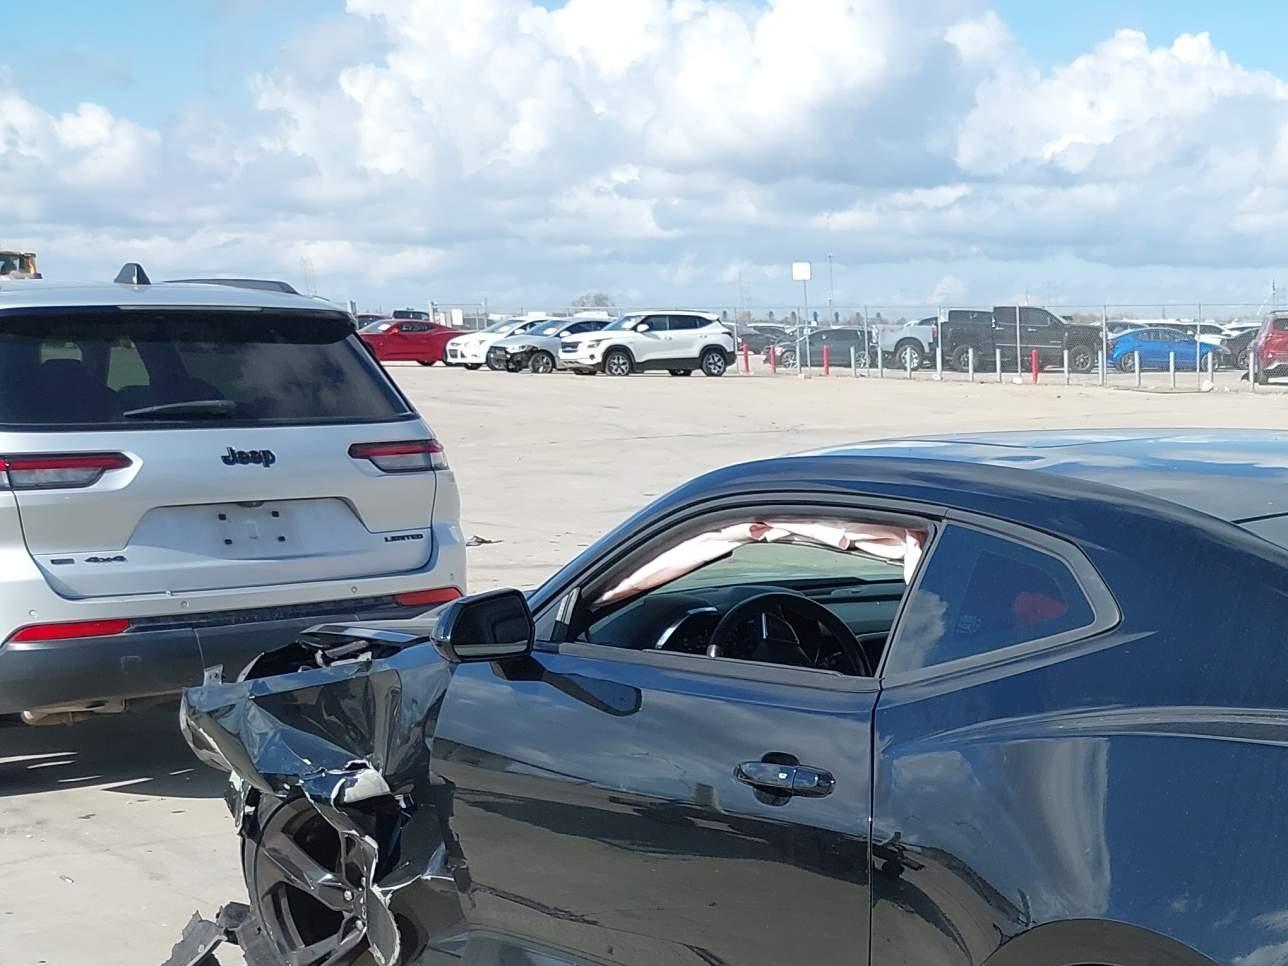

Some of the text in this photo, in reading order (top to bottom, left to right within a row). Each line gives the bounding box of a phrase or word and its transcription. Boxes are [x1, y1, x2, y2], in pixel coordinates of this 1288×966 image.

[221, 447, 275, 467] Jeep
[384, 533, 423, 542] LIMITED
[84, 555, 127, 563] 4x4
